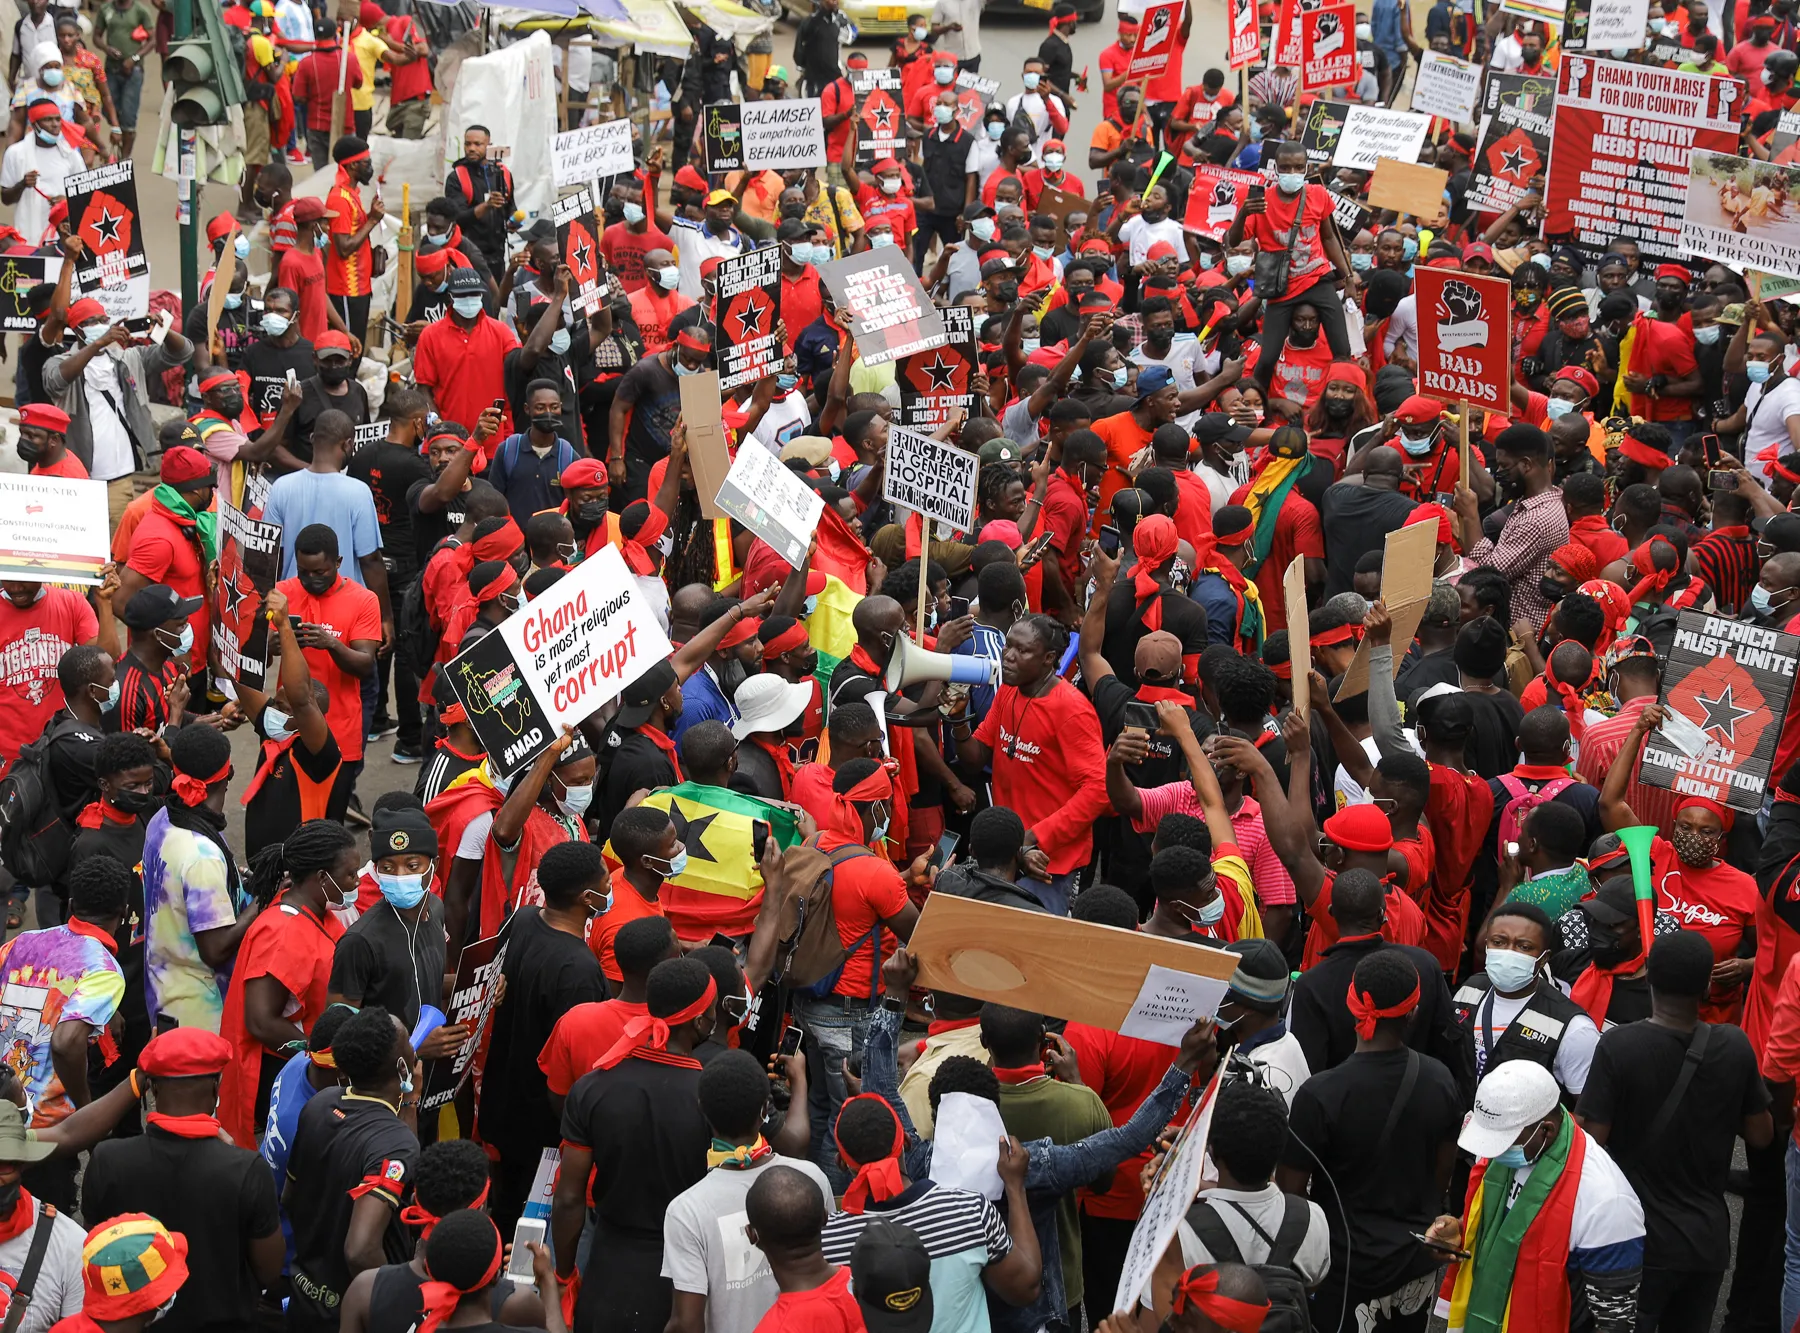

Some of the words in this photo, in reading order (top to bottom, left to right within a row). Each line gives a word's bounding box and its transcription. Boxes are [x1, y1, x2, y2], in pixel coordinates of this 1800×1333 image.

[1232, 32, 1256, 56] BAD
[1305, 54, 1352, 74] KILLER
[1308, 67, 1351, 84] RENTS
[854, 80, 878, 91] MUST
[1597, 66, 1632, 88] GHANA
[1636, 72, 1670, 93] YOUTH
[1673, 78, 1706, 98] ARISE
[1600, 88, 1620, 106] FOR
[1622, 91, 1645, 110] OUR
[1648, 94, 1698, 118] COUNTRY
[743, 106, 816, 126] GALAMSEY
[1351, 112, 1376, 124] Stop
[1376, 114, 1424, 133] installing
[1498, 112, 1516, 126] CAN
[1516, 119, 1536, 132] YOU
[556, 135, 575, 152] WE
[578, 124, 629, 146] DESERVE
[747, 130, 757, 140] is
[759, 125, 816, 142] unpatriotic
[1350, 124, 1401, 142] foreigners
[1402, 134, 1416, 142] as
[1602, 114, 1628, 134] THE
[1629, 118, 1698, 147] COUNTRY
[560, 152, 581, 169] THE
[584, 144, 608, 163] BEST
[612, 142, 631, 154] TOO
[748, 143, 818, 160] BEHAVIOUR
[1358, 138, 1400, 152] traditional
[1592, 134, 1636, 156] NEEDS
[64, 159, 132, 188] ACCOUNTABILITY
[714, 158, 739, 168] #MAD
[1592, 158, 1626, 176] ENOUGH
[1627, 164, 1639, 177] OF
[1639, 166, 1656, 180] THE
[1656, 168, 1690, 186] KILLING
[68, 186, 78, 198] IN
[78, 170, 132, 193] GOVERNMENT
[1200, 166, 1261, 186] #FIXTHECOUNTRY
[1475, 172, 1487, 185] ON
[1489, 176, 1510, 192] 700
[1580, 170, 1614, 188] ENOUGH
[1615, 177, 1627, 190] OF
[1627, 179, 1644, 193] THE
[1476, 184, 1492, 196] PER
[1580, 186, 1615, 203] ENOUGH
[1616, 192, 1628, 205] OF
[1628, 194, 1644, 209] THE
[1568, 199, 1602, 216] ENOUGH
[1603, 204, 1616, 218] OF
[1616, 207, 1631, 222] THE
[1632, 210, 1662, 227] POLICE
[1574, 215, 1590, 229] THE
[1590, 217, 1620, 234] POLICE
[1620, 224, 1640, 239] AND
[1640, 226, 1657, 241] THE
[1580, 230, 1607, 246] NEEDS
[1683, 224, 1706, 239] FIX
[1709, 229, 1736, 245] THE
[96, 255, 103, 265] A
[104, 249, 125, 264] NEW
[1684, 238, 1712, 254] MR.
[79, 254, 144, 284] CONSTITUTION
[720, 264, 726, 276] 1
[726, 252, 760, 274] BILLION
[762, 247, 780, 260] PER
[720, 267, 744, 288] YEAR
[744, 262, 767, 280] LOST
[768, 258, 780, 272] TO
[722, 273, 778, 299] CORRUPTION
[844, 272, 906, 300] POLITICS
[845, 264, 890, 286] PARTY
[1772, 279, 1791, 290] TIME
[850, 294, 878, 312] DEY
[881, 286, 912, 304] KILL
[861, 298, 912, 321] WANNA
[4, 316, 36, 329] #MAD
[860, 306, 923, 334] COUNTRY
[946, 308, 968, 321] PER
[958, 318, 972, 332] TO
[724, 343, 746, 362] ...BUT
[748, 334, 776, 350] COURT
[864, 332, 946, 366] #FIXTHECOUNTRY
[728, 355, 751, 374] BUSY
[752, 348, 774, 365] WITH
[1439, 352, 1482, 376] BAD
[720, 367, 760, 390] CASSAVA
[762, 358, 784, 376] THIEF
[1424, 370, 1498, 402] ROADS
[906, 396, 937, 410] ...BUT
[939, 394, 975, 407] COURT
[912, 410, 940, 423] BUSY
[892, 430, 932, 459] BRING
[934, 447, 974, 475] BACK
[890, 446, 906, 464] LA
[910, 454, 970, 489] GENERAL
[890, 460, 969, 506] HOSPITAL
[12, 534, 58, 544] GENERATION
[12, 550, 59, 560] #AriseGhanaYouth
[523, 589, 589, 653] Ghana
[534, 654, 546, 671] is
[548, 626, 578, 660] most
[580, 589, 631, 637] religious
[6, 638, 24, 653] 2014
[226, 629, 239, 651] NEW
[1702, 616, 1778, 652] AFRICA
[1674, 628, 1732, 658] MUST
[1734, 645, 1798, 677] UNITE
[6, 670, 34, 687] FINAL
[482, 662, 516, 692] MOVEMENT
[544, 665, 562, 694] yet
[564, 641, 592, 673] most
[553, 620, 637, 713] corrupt
[490, 678, 523, 706] DISORDER
[504, 727, 544, 766] #MAD
[1642, 746, 1765, 794] CONSTITUTION
[1676, 776, 1720, 800] NOW!
[1657, 870, 1728, 926] Super
[1154, 994, 1190, 1004] NABCO
[1164, 986, 1188, 994] #FIX
[1146, 1002, 1196, 1014] TRAINEEZ
[294, 1272, 326, 1302] unicef
[726, 1277, 754, 1290] BIGGER
